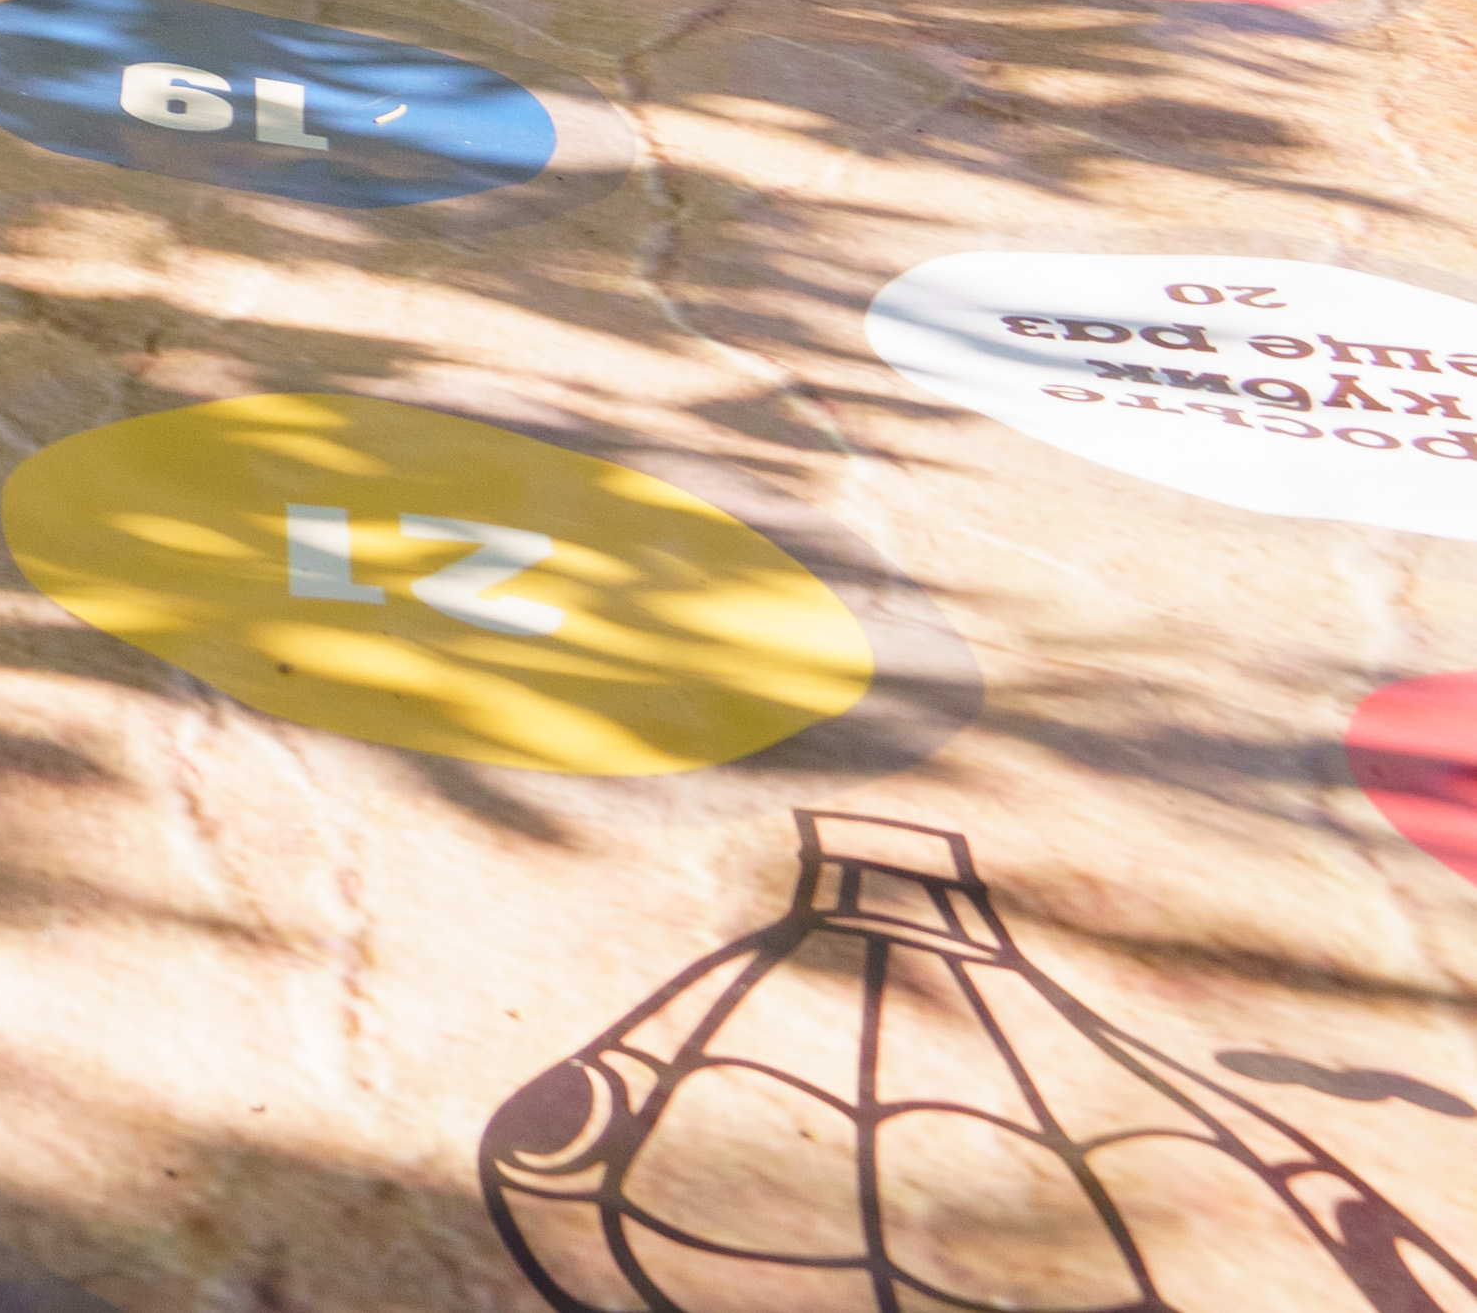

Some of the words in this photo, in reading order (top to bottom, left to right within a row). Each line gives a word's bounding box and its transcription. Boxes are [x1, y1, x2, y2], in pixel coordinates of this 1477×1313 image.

[120, 62, 330, 151] 19
[1162, 282, 1287, 310] 20
[999, 314, 1217, 354] раз
[1083, 358, 1473, 420] кубик
[287, 501, 565, 637] 21
